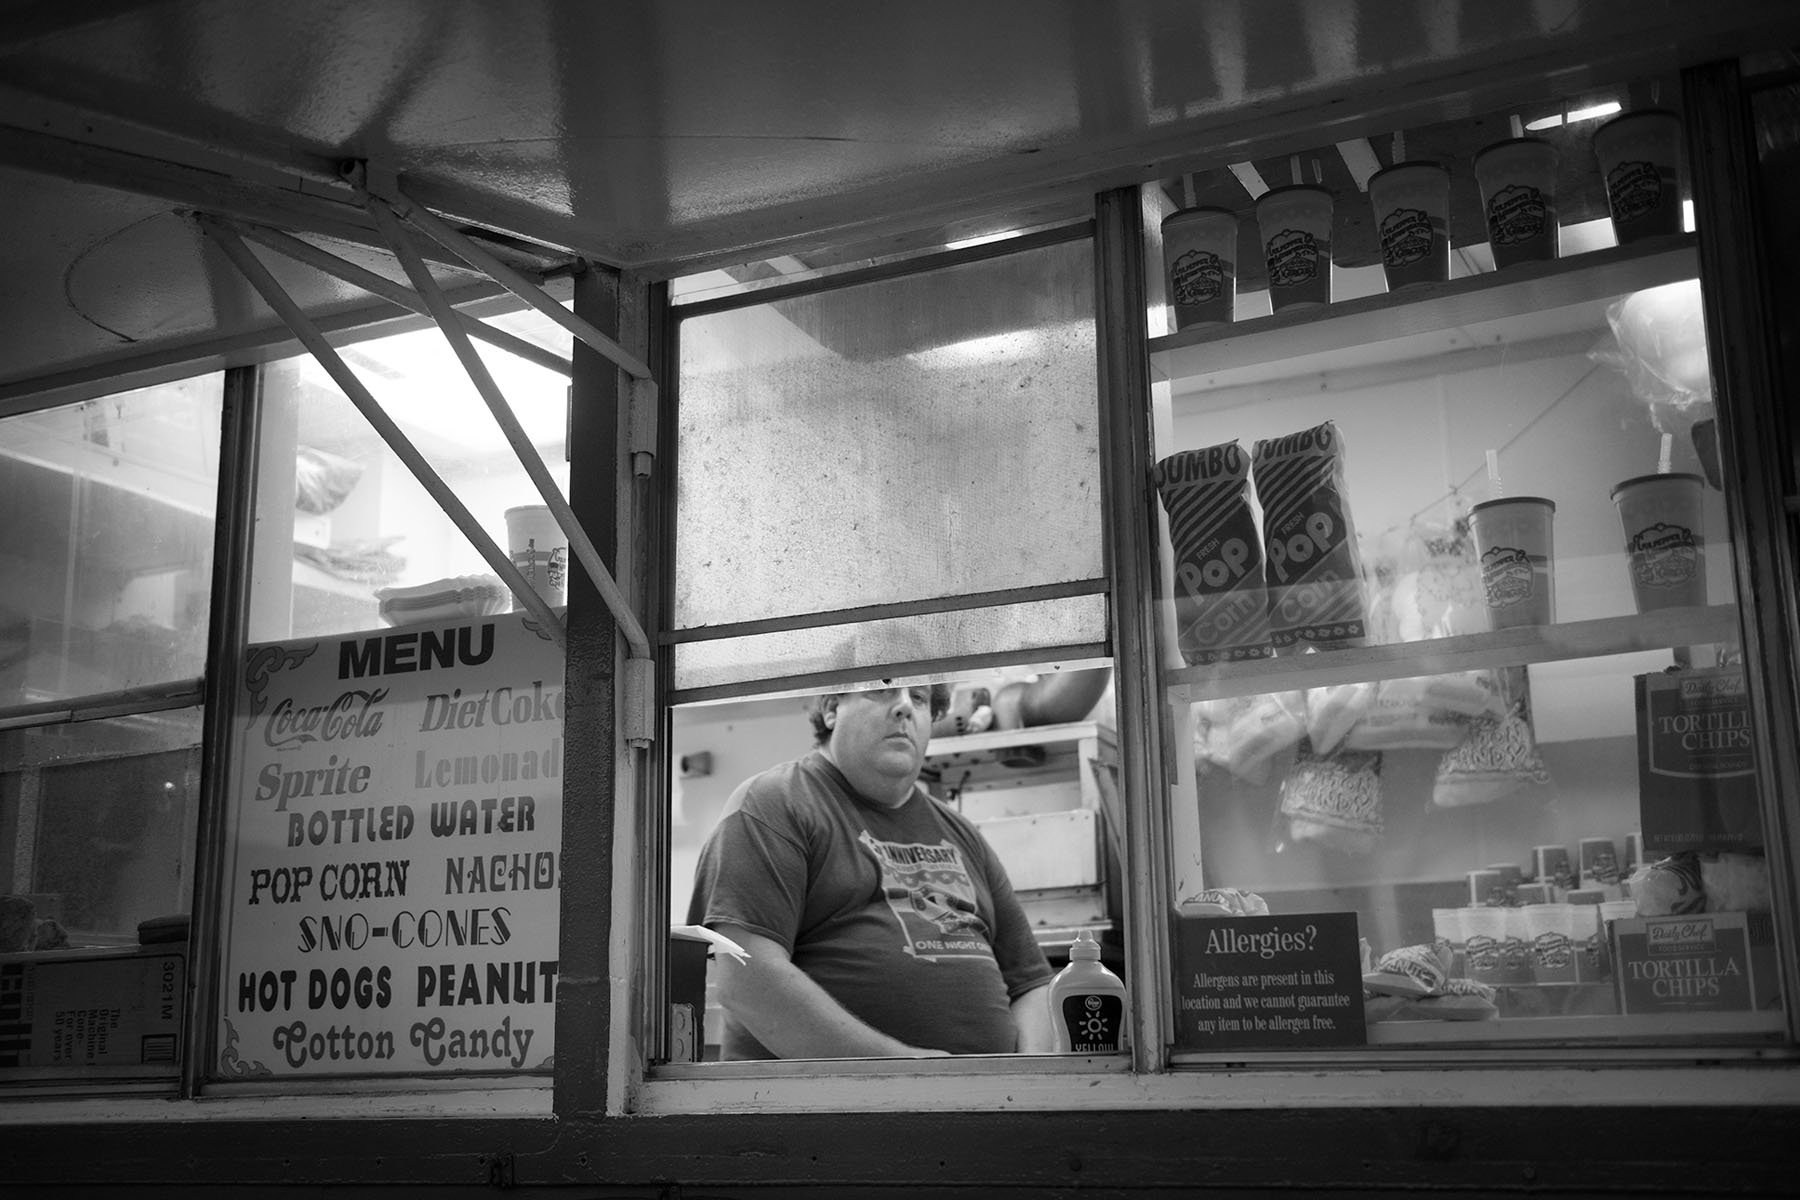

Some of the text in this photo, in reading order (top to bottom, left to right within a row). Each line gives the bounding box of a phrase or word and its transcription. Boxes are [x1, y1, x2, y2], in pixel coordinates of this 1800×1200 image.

[1157, 443, 1241, 488] JUMBO
[1196, 538, 1219, 560] FRESH
[338, 624, 495, 679] MENU
[264, 688, 390, 747] Coca-Cola
[419, 689, 489, 732] Diet
[1682, 728, 1750, 750] CHIPS
[254, 755, 371, 812] Sprite
[288, 796, 535, 847] BOTTLED WATER
[249, 860, 410, 905] POP CORN
[445, 852, 561, 895] NACHO
[298, 906, 512, 953] SNO-CONES
[916, 940, 944, 950] ONE
[945, 941, 976, 950] NIGHT
[1205, 925, 1318, 959] Allergies?
[1681, 924, 1707, 941] Chef
[238, 969, 297, 1013] HOT
[308, 966, 392, 1010] DOGS
[1193, 970, 1335, 991] Allergens are present in this
[1628, 957, 1742, 980] TORTILLA
[1652, 977, 1720, 997] CHIPS
[162, 961, 176, 1020] 3021M
[1182, 993, 1350, 1011] location and we cannot guarantee
[65, 1010, 76, 1029] For
[87, 1009, 98, 1059] Machine
[97, 1008, 109, 1055] Original
[110, 1008, 120, 1029] The
[1198, 1015, 1336, 1034] any item to be allergen free.
[273, 1016, 535, 1068] Cotton Candy
